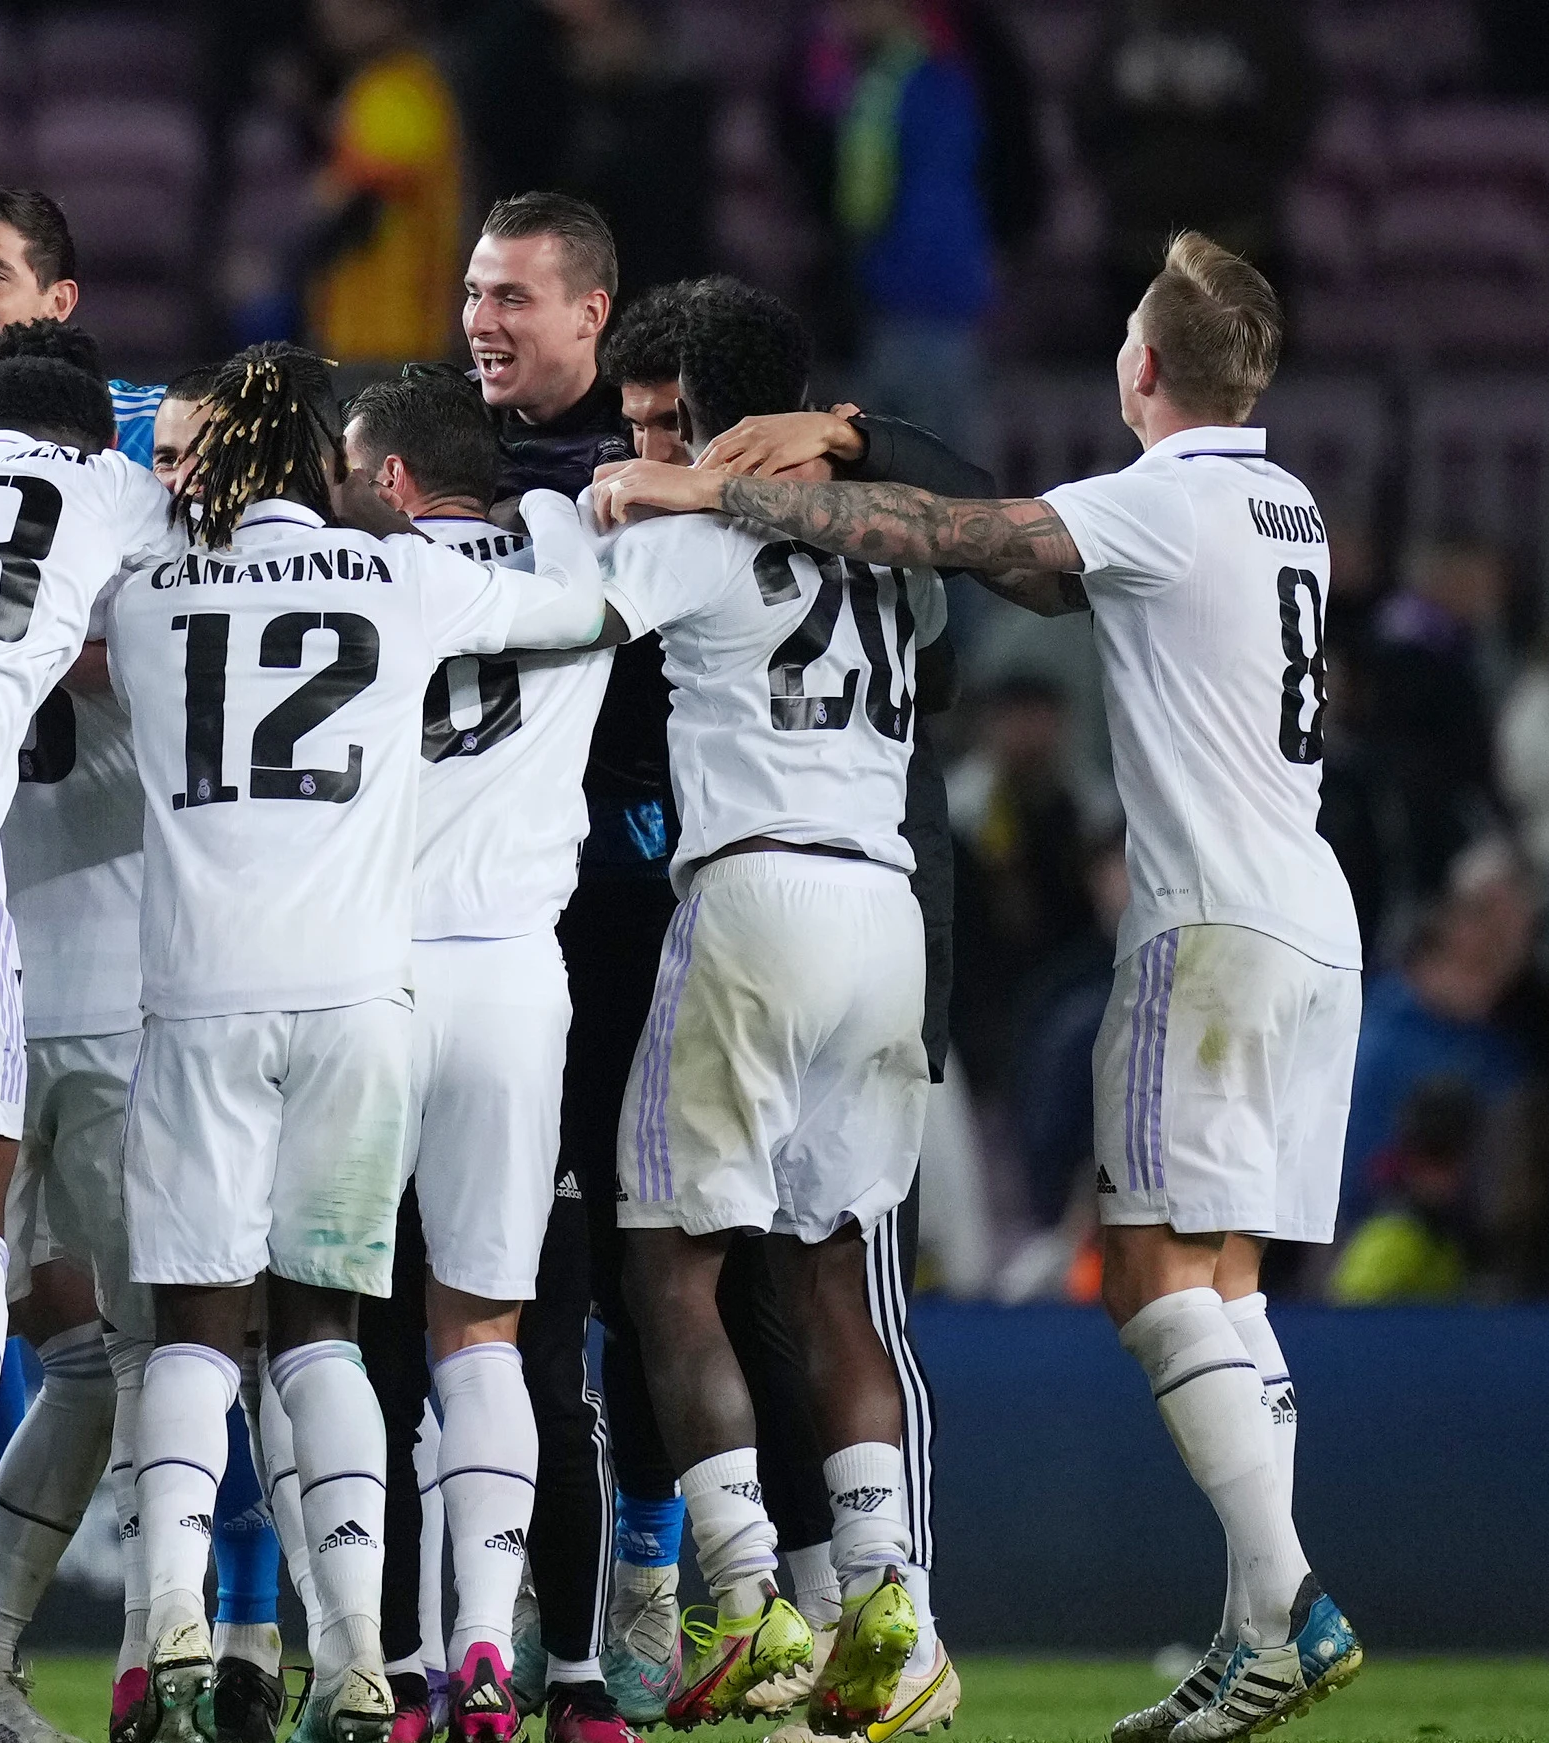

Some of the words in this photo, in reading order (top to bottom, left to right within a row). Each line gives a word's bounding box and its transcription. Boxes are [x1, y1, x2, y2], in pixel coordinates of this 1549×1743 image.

[1248, 497, 1324, 543] KROOS
[151, 548, 393, 590] CAMAVINGA
[752, 540, 916, 743] 20
[1276, 566, 1328, 765] 8
[170, 611, 380, 811] 12
[555, 1187, 582, 1199] adidas
[318, 1534, 378, 1553] adidas
